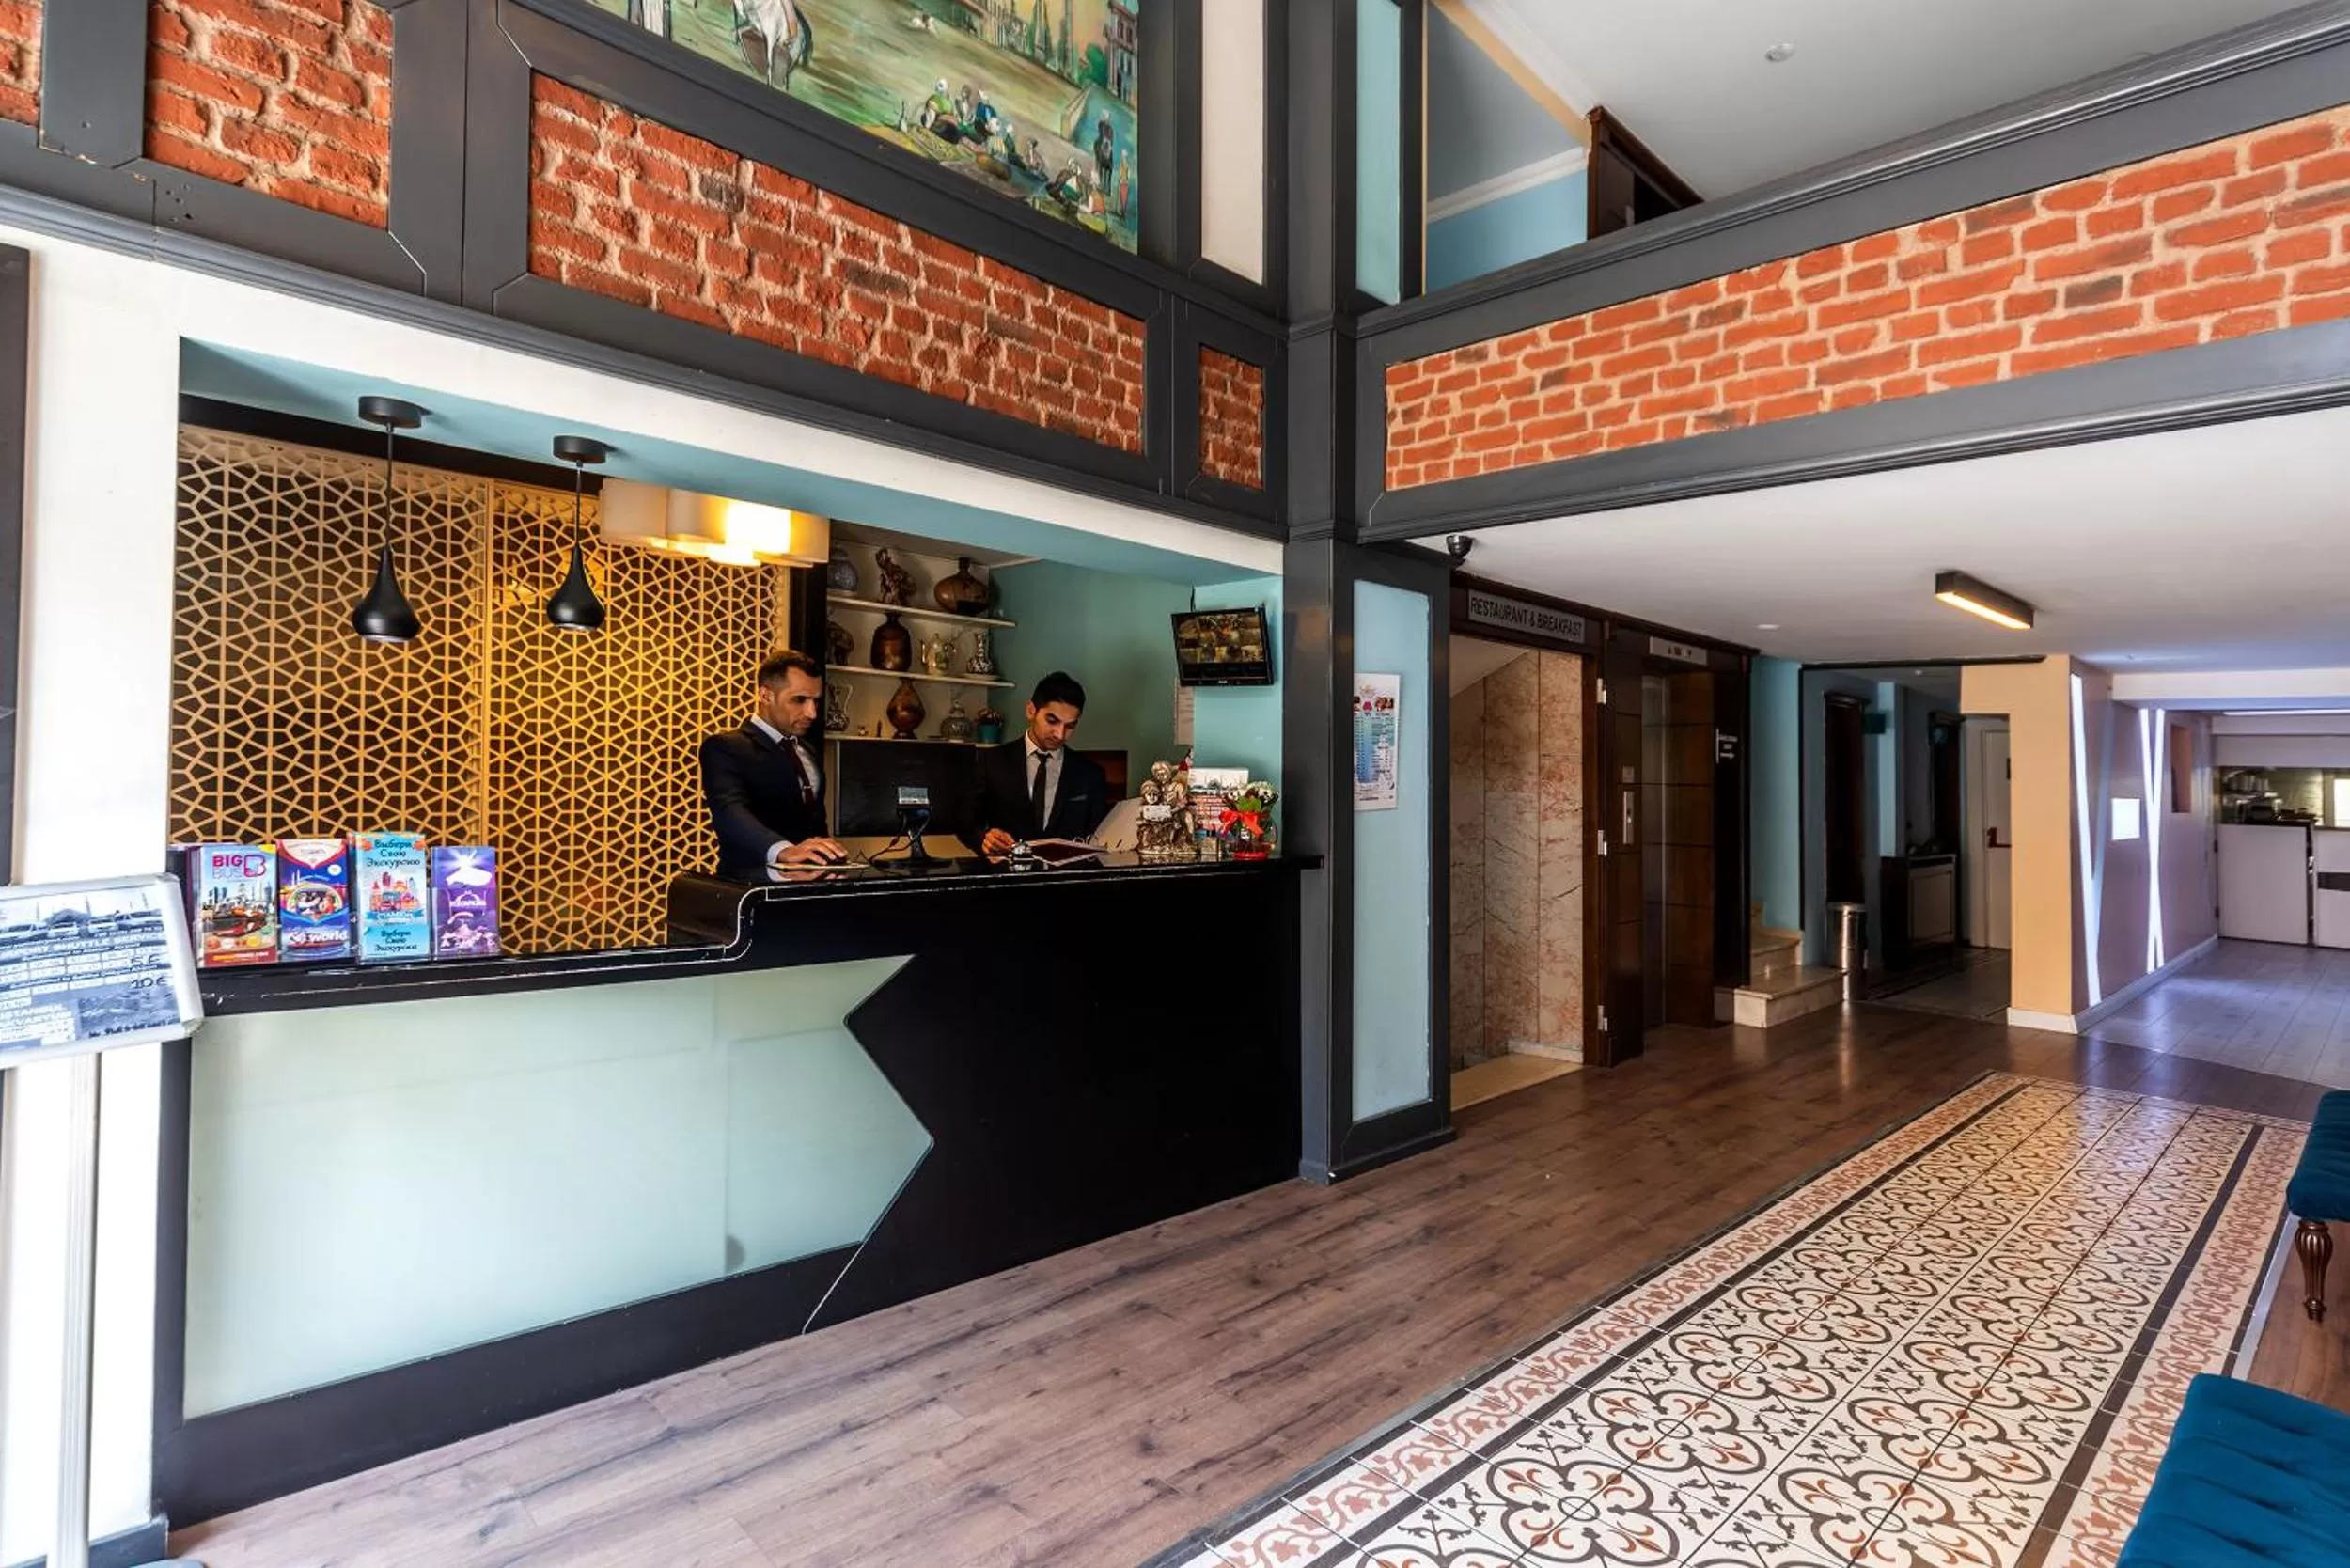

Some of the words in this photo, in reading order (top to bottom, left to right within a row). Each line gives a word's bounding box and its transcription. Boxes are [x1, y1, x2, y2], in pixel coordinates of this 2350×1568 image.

[1470, 597, 1528, 627] RESTAURANT
[1529, 611, 1536, 628] &
[1537, 613, 1583, 638] BREAKFAST
[380, 850, 407, 858] Свою
[212, 855, 243, 868] BIG
[366, 857, 421, 869] Экскурсию
[212, 868, 243, 879] BUS
